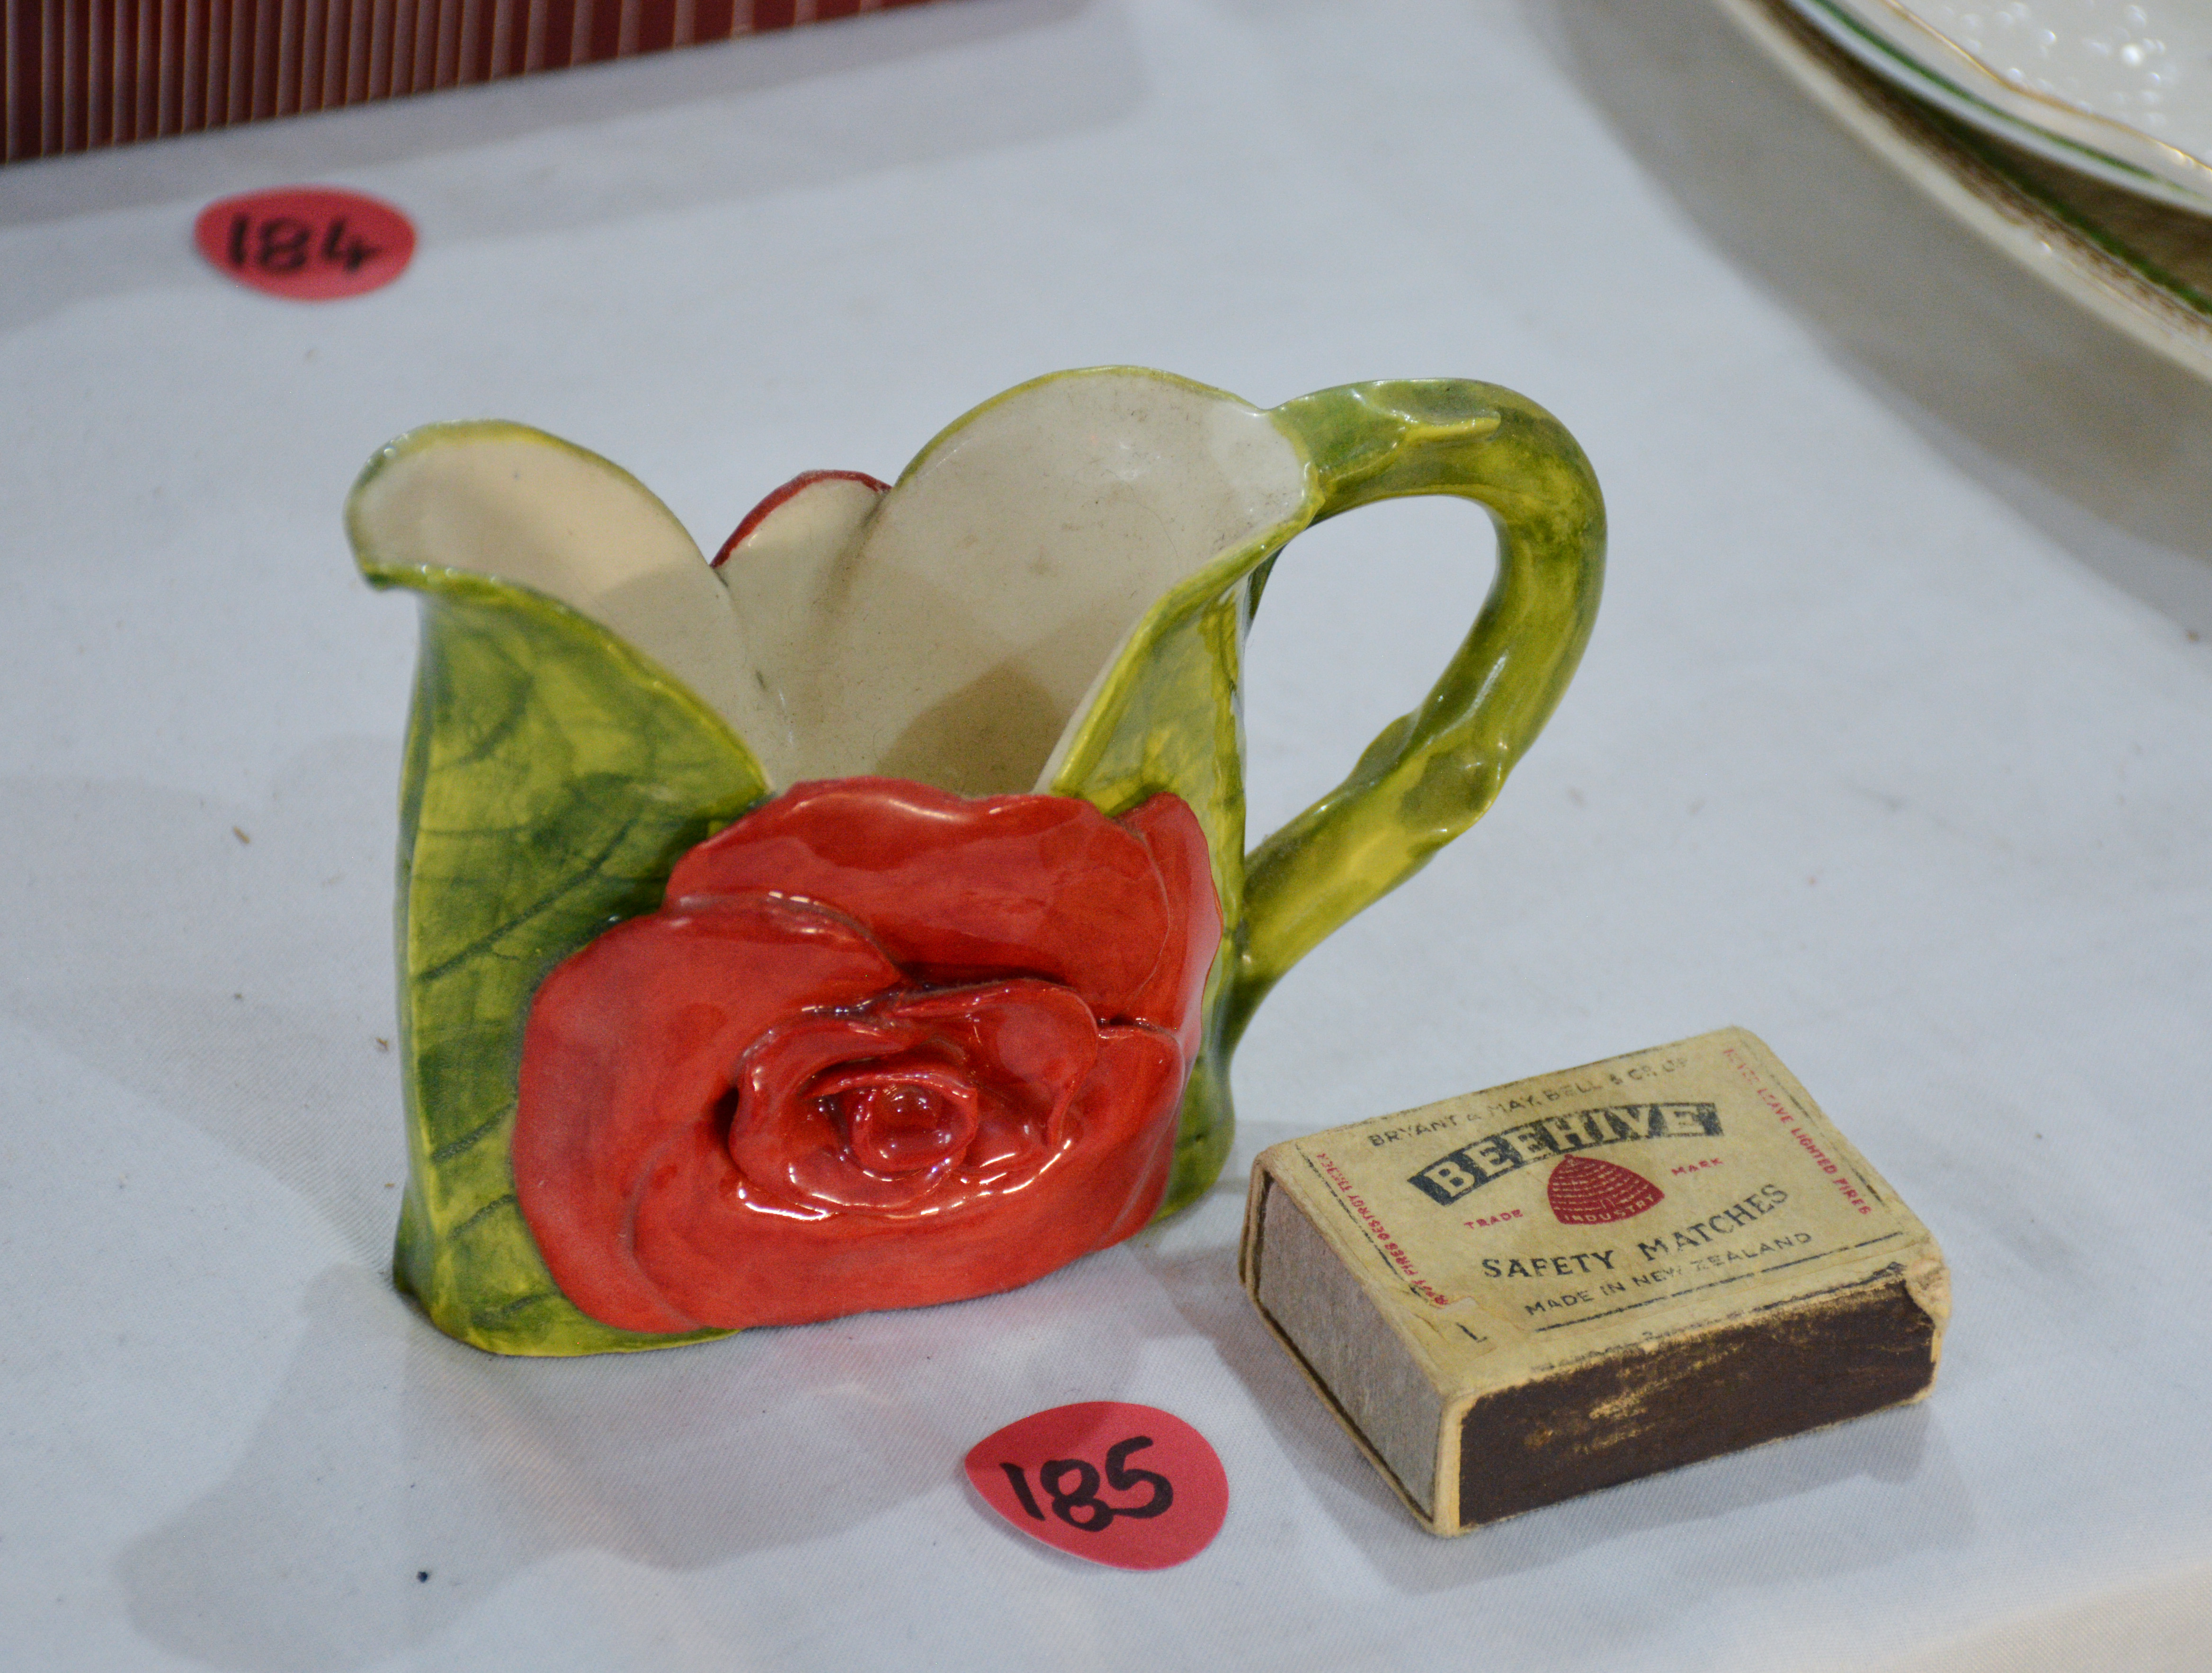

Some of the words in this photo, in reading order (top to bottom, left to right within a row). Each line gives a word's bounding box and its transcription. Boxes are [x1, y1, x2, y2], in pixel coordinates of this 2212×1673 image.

[227, 212, 382, 275] 184
[1369, 1115, 1457, 1146] BRYANT
[1423, 1106, 1710, 1198] BEEHIVE
[1671, 1157, 1723, 1175] MARK
[1791, 1127, 1838, 1174] LIGHTED
[1832, 1178, 1873, 1215] FIRES
[1347, 1195, 1390, 1241] DESTROY
[1464, 1209, 1524, 1229] TRADE
[1482, 1250, 1615, 1278] SAFETY
[1638, 1184, 1788, 1261] MATCHES
[1564, 1193, 1654, 1222] INDUSTRY
[1384, 1243, 1418, 1276] FIRES
[1525, 1290, 1593, 1315] MADE
[1600, 1280, 1626, 1296] IN
[1690, 1232, 1812, 1270] ZEALAND
[999, 1436, 1173, 1532] 185
